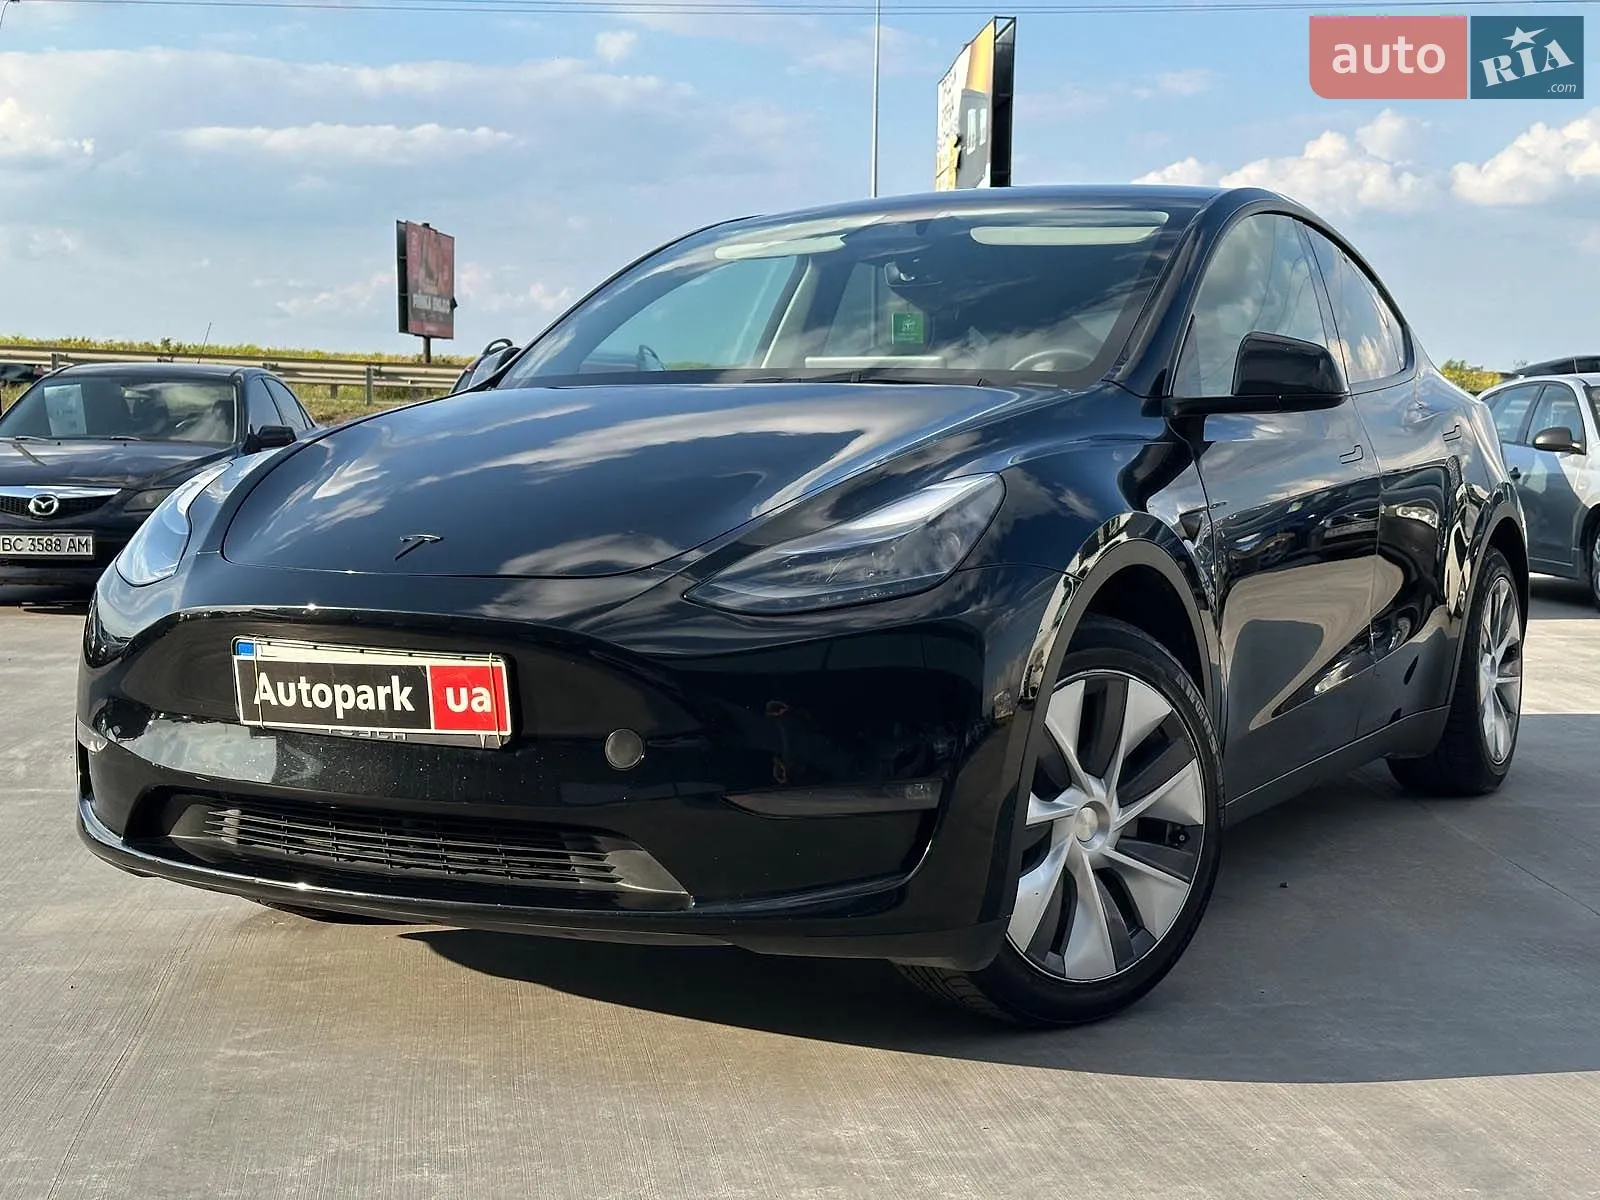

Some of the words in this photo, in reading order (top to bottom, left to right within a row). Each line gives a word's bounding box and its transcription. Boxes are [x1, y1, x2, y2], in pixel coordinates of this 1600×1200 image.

[1, 537, 23, 552] BC
[28, 537, 61, 552] 3588
[66, 538, 88, 553] AM
[254, 671, 415, 720] Autopark
[445, 684, 492, 713] ua
